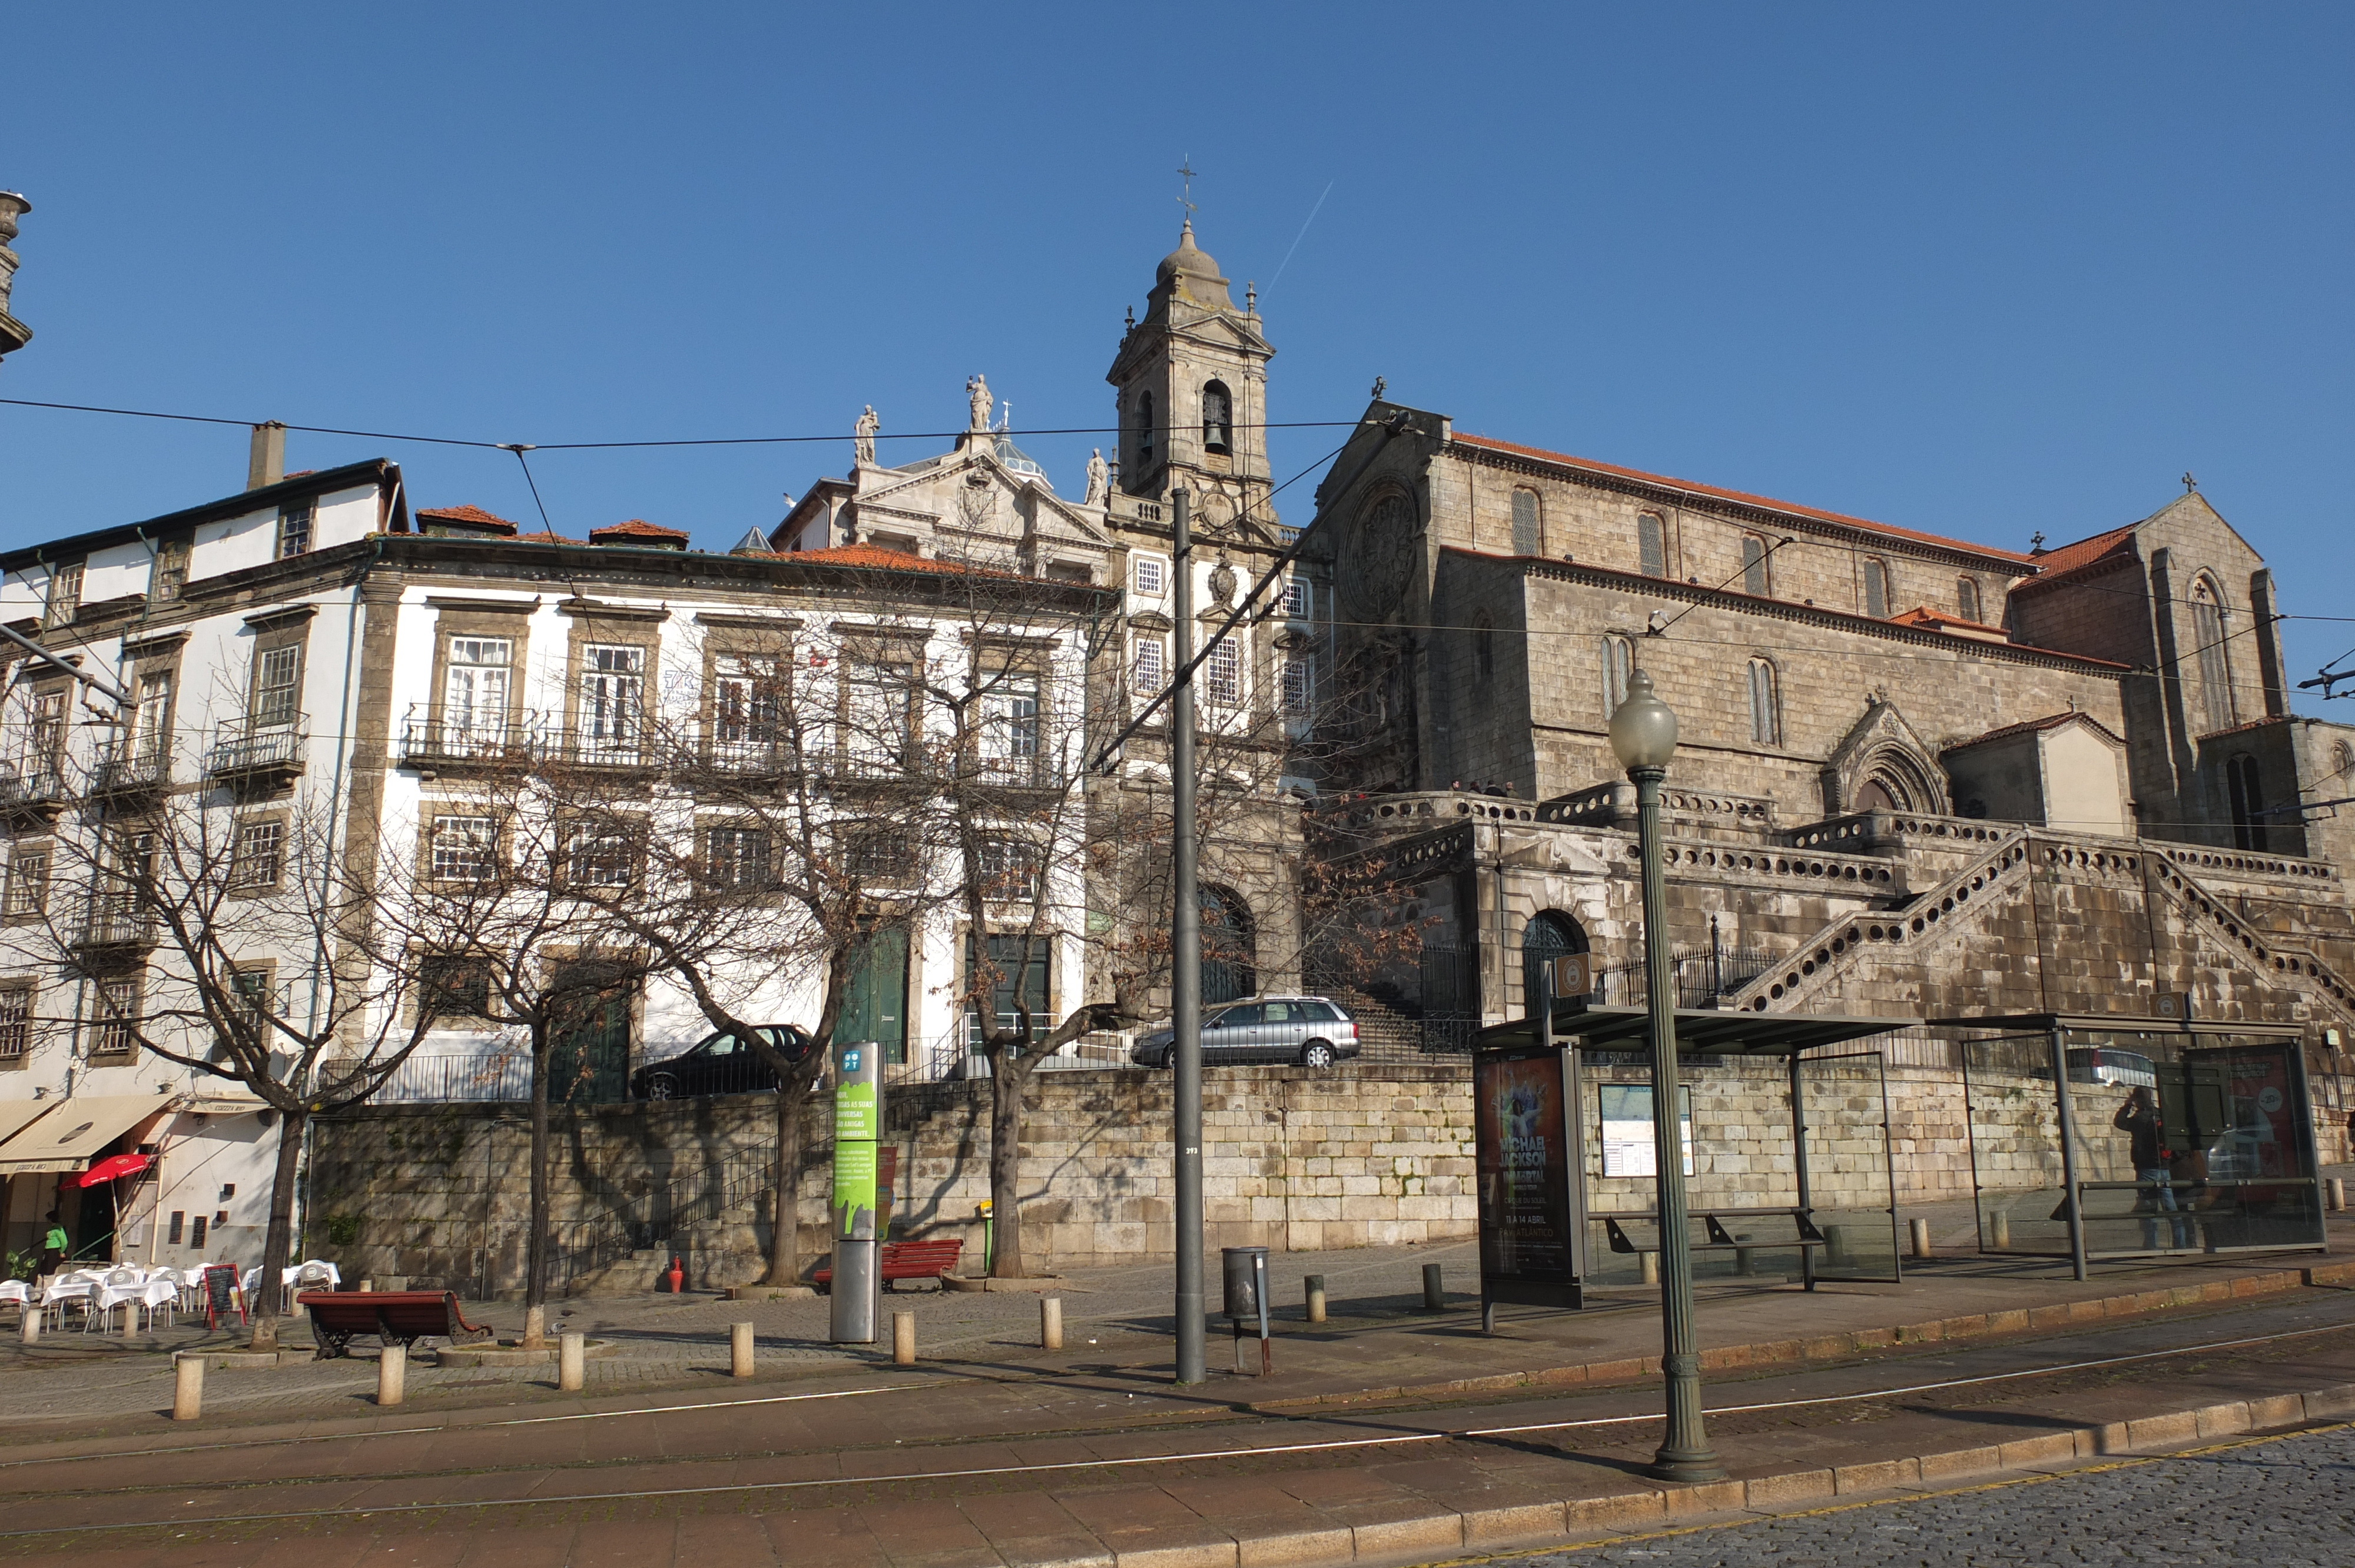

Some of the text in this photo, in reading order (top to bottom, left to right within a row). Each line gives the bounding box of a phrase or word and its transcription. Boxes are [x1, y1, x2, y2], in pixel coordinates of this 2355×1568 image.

[1500, 1135, 1545, 1152] MICHAEL
[1499, 1151, 1546, 1167] JACKSON
[1506, 1215, 1546, 1224] 11 A 14 ABRIL
[1516, 1226, 1554, 1237] ATLÂNTICO
